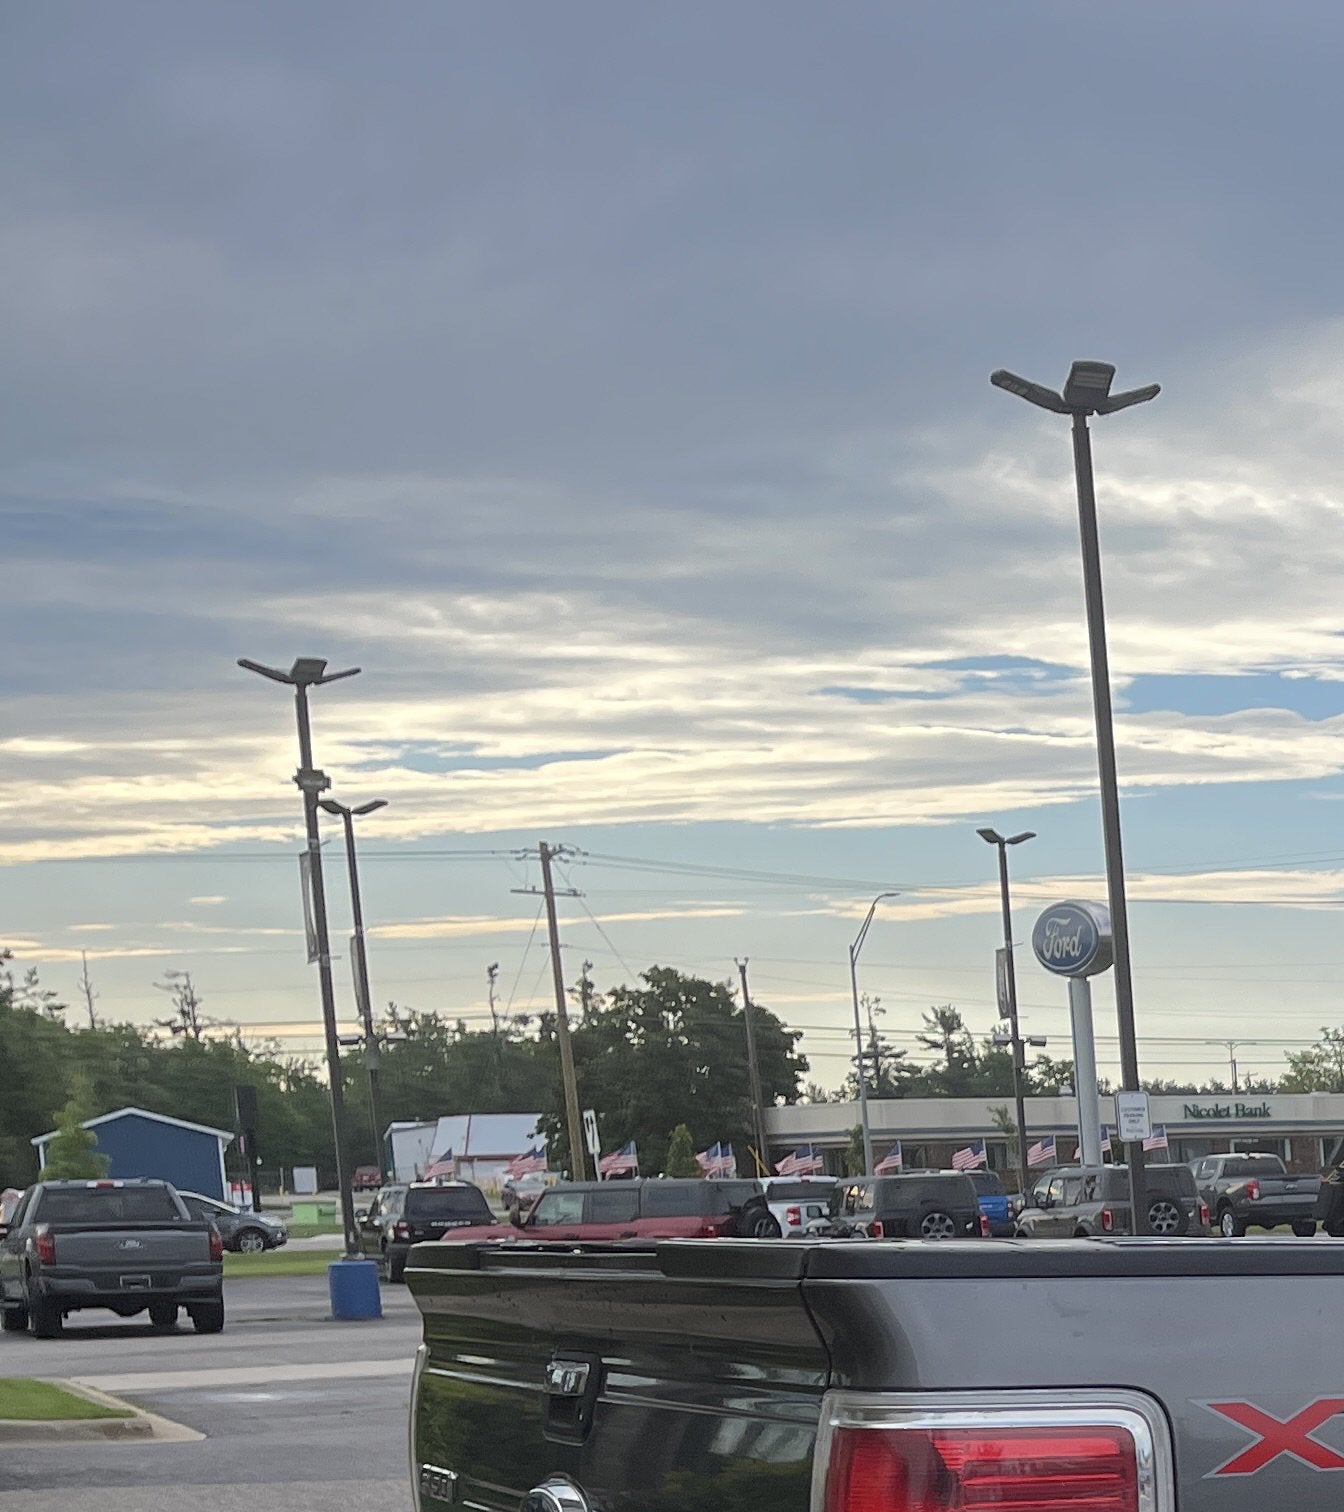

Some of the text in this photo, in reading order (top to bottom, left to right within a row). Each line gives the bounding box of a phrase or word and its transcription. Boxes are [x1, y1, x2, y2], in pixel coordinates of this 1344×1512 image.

[1042, 917, 1083, 960] Ford
[1183, 1102, 1272, 1119] Nicolet Bank
